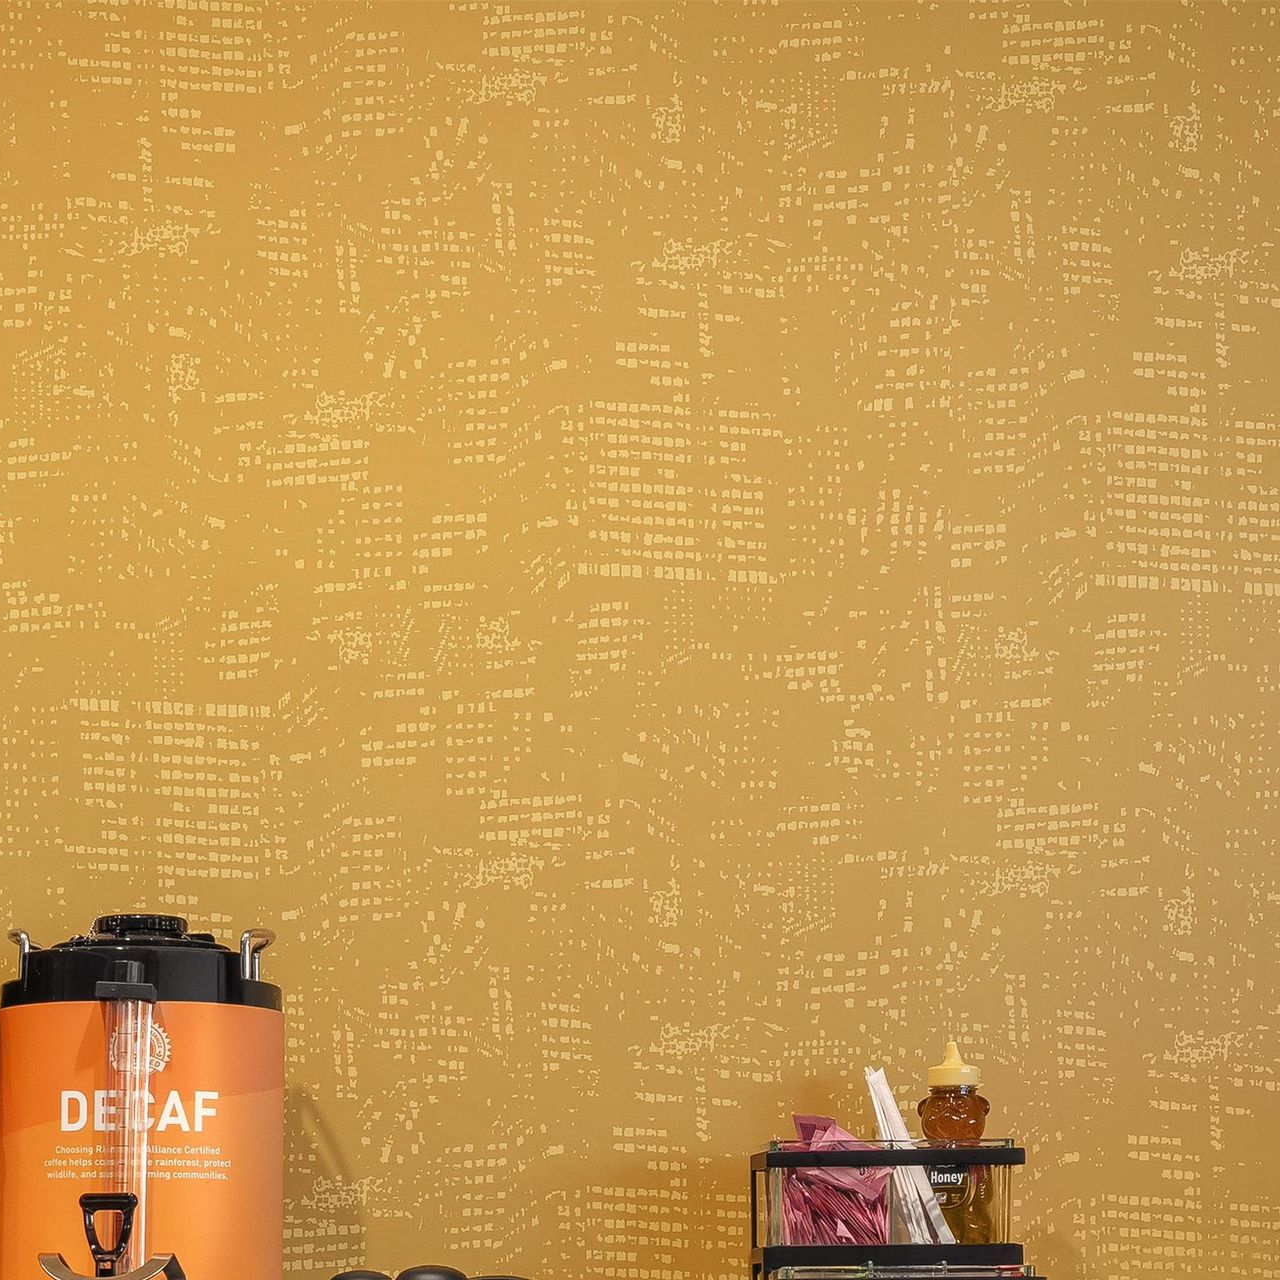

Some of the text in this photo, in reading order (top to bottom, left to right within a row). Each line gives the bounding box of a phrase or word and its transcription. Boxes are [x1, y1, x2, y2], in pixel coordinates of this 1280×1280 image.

[60, 1090, 220, 1133] DECAF
[55, 1145, 94, 1156] Choosing
[184, 1146, 221, 1155] Certified
[44, 1158, 68, 1167] coffee
[69, 1158, 93, 1168] helps
[155, 1158, 202, 1168] rainforest,
[203, 1159, 232, 1168] protect
[47, 1170, 78, 1180] wildlife,
[80, 1170, 97, 1179] and
[172, 1170, 229, 1181] communities.
[930, 1171, 964, 1185] Honey
